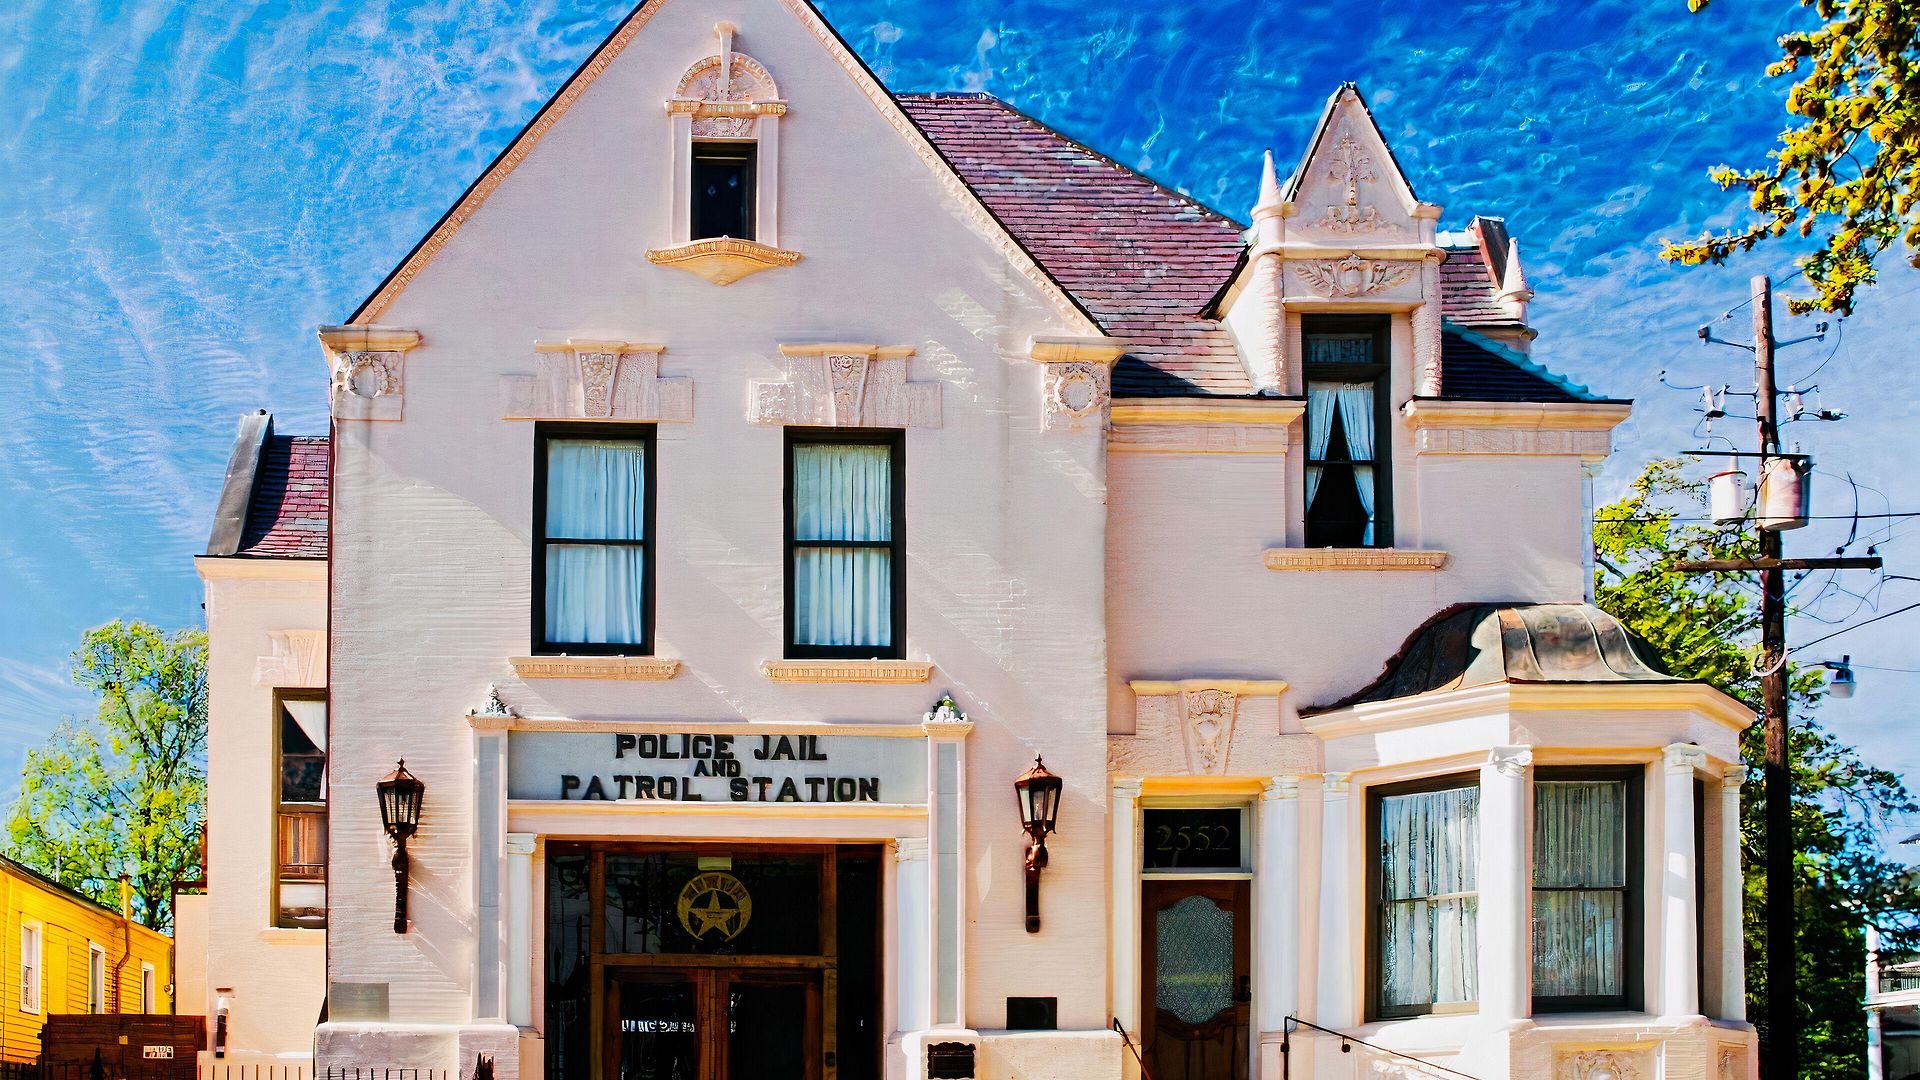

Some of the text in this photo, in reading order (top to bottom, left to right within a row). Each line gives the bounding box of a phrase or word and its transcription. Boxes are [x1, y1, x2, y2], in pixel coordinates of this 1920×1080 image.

[615, 733, 827, 761] POLICE JAIL
[693, 759, 741, 777] AND
[561, 775, 879, 802] PATROL STATION
[1156, 825, 1231, 850] 2552
